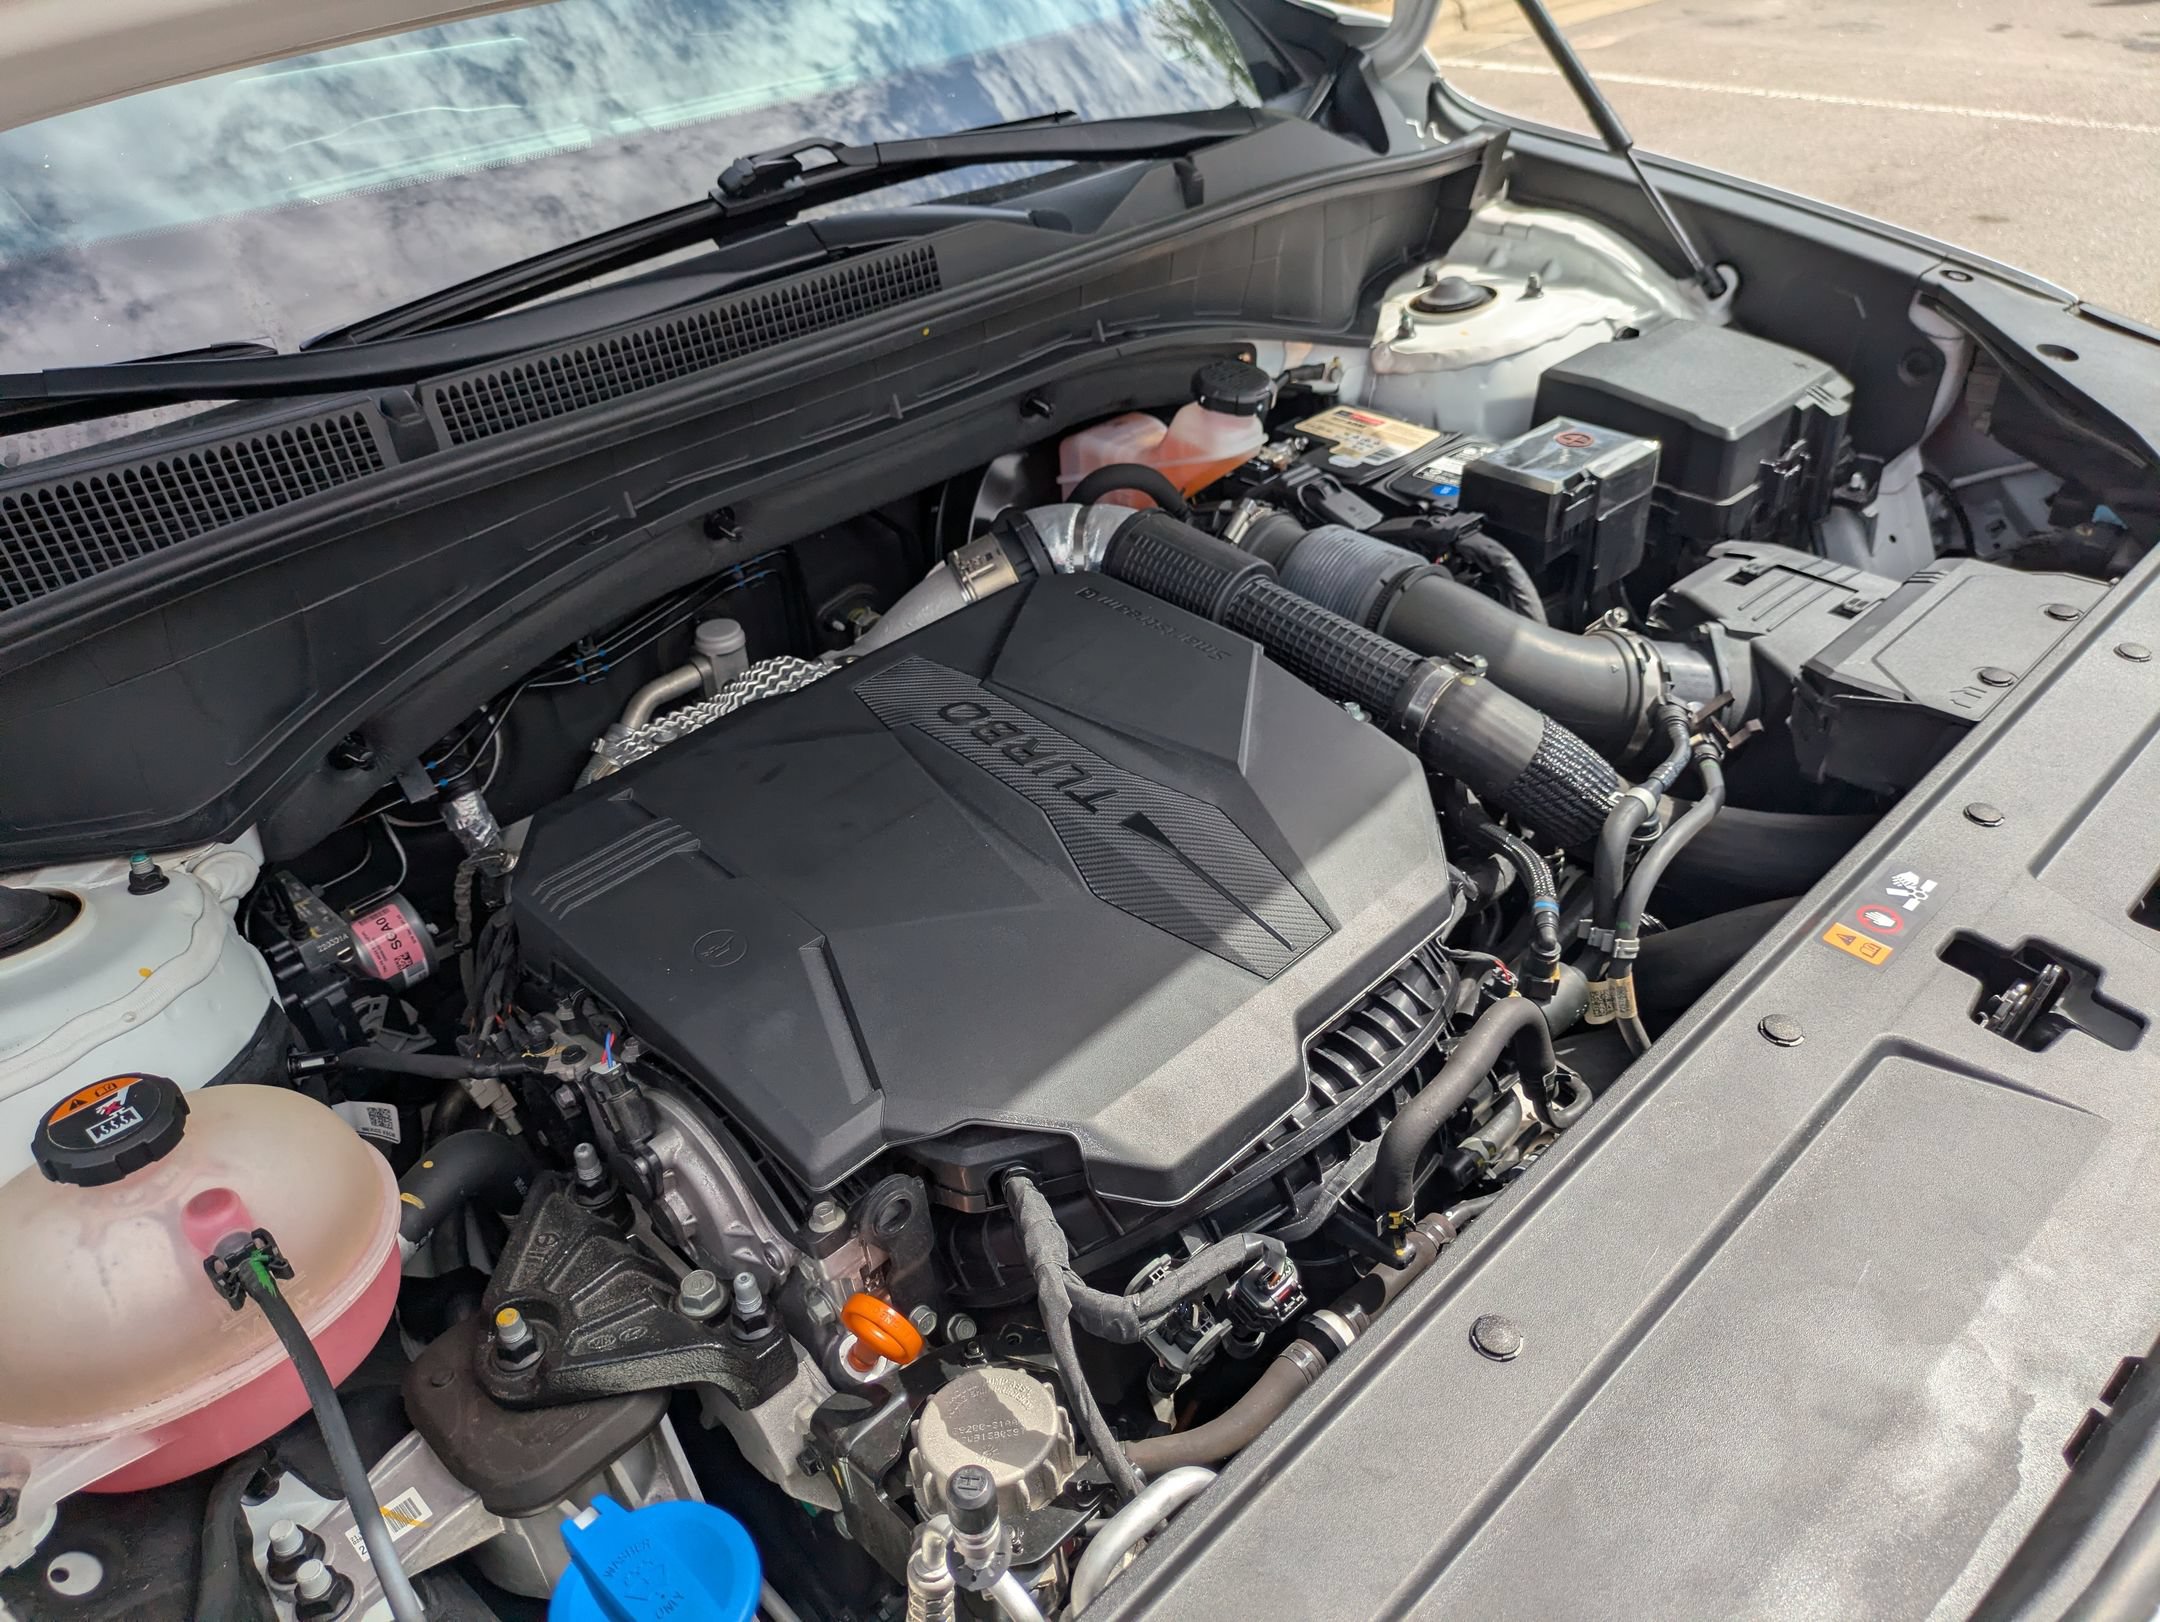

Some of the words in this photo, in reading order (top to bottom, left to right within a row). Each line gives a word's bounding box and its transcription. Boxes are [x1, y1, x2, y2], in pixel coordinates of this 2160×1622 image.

[1098, 596, 1232, 661] Smartstream
[937, 701, 1120, 815] TURBO
[603, 1538, 651, 1577] WASHER
[656, 1591, 684, 1619] ONLY
